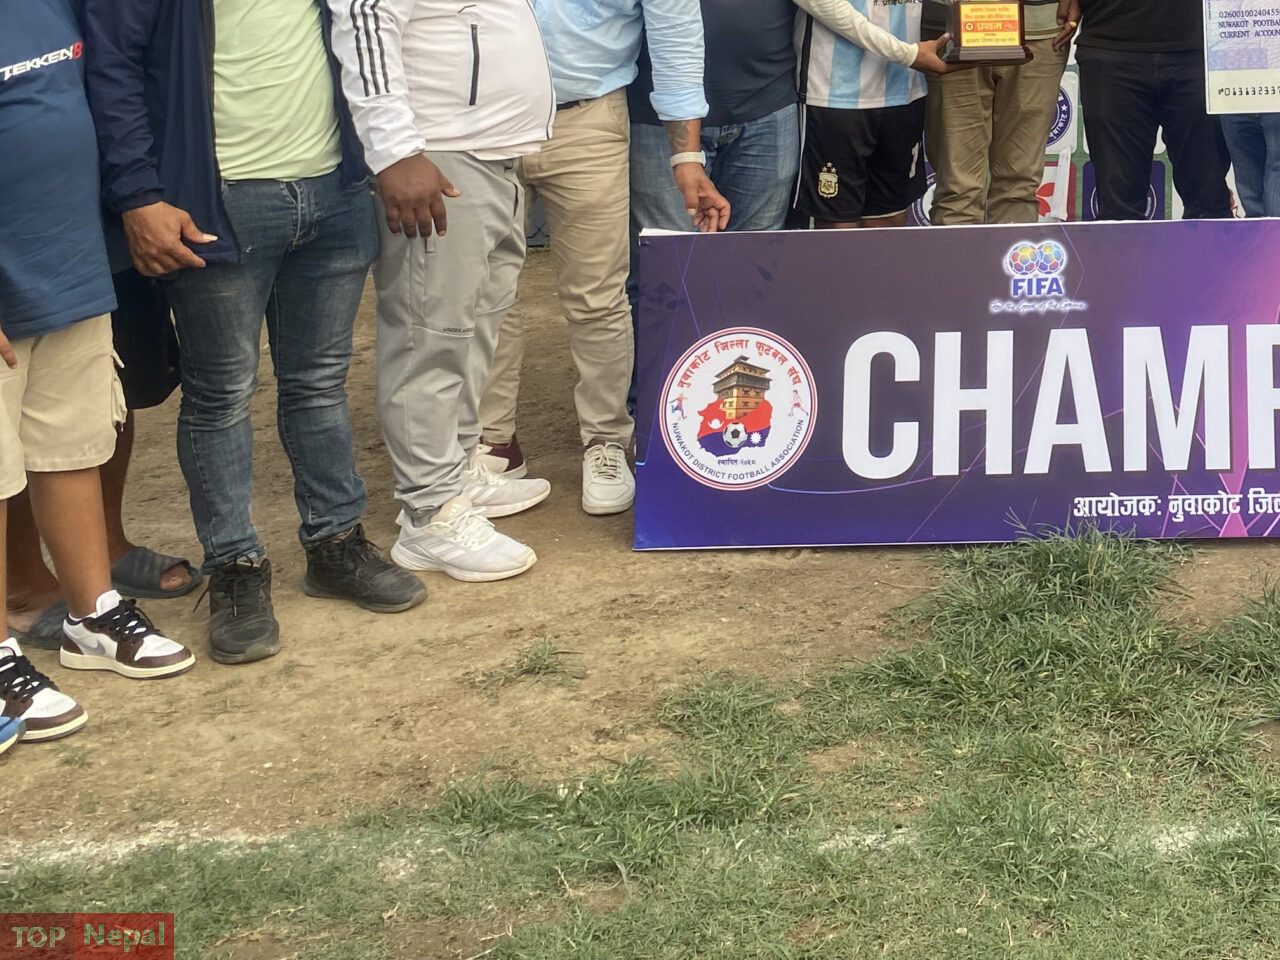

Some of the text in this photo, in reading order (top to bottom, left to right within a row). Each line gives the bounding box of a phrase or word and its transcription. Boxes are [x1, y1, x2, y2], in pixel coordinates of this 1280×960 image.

[1218, 20, 1249, 29] NUWAKOT
[1220, 30, 1250, 39] CURRENT
[1012, 277, 1063, 296] FIFA
[677, 349, 711, 388] नुवाकोट
[714, 339, 750, 354] जिल्ला
[672, 419, 804, 481] NUWAKOT DISTRICT FOOTBALL ASSOCIATION
[1073, 491, 1162, 517] आयोजक:
[1168, 490, 1241, 523] नुवाकोट
